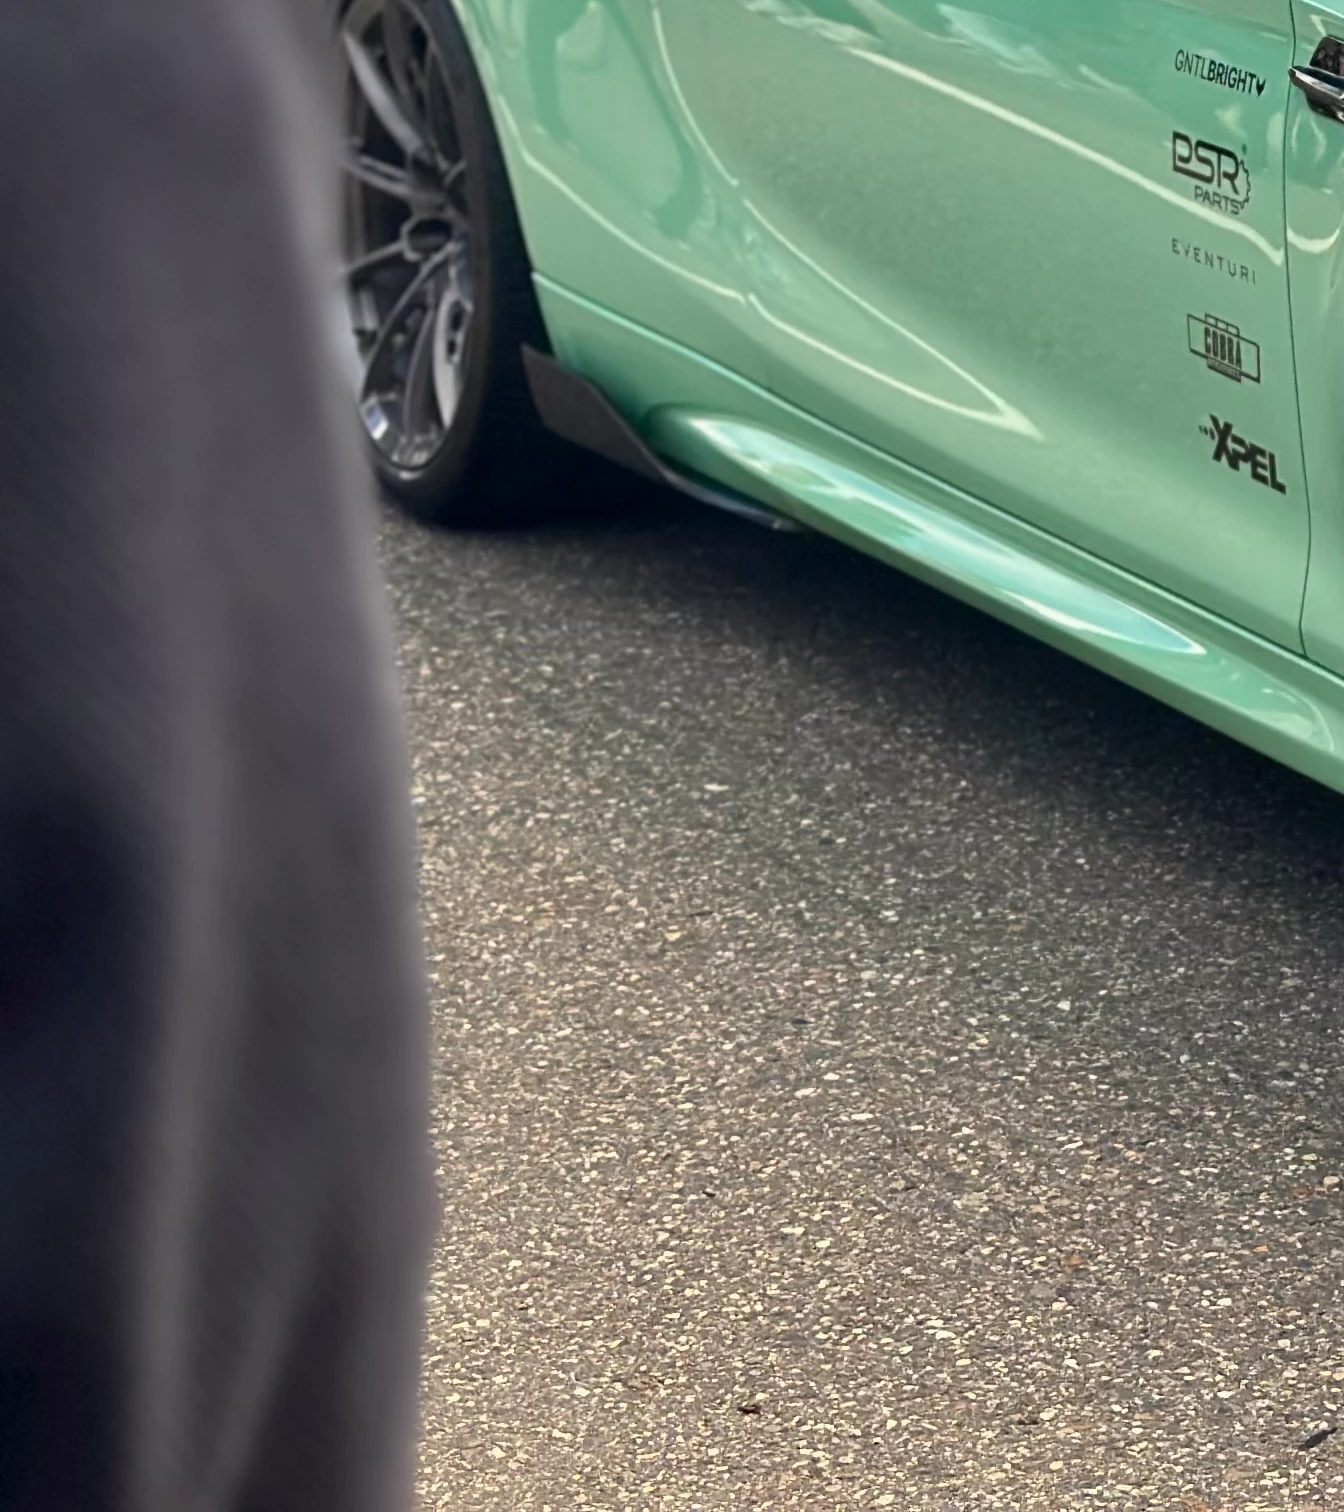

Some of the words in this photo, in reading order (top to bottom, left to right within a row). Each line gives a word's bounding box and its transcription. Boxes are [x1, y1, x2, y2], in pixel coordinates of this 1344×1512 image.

[1194, 184, 1241, 216] PARTS
[1171, 237, 1256, 286] EVENTURI
[1209, 413, 1287, 497] XPEL
